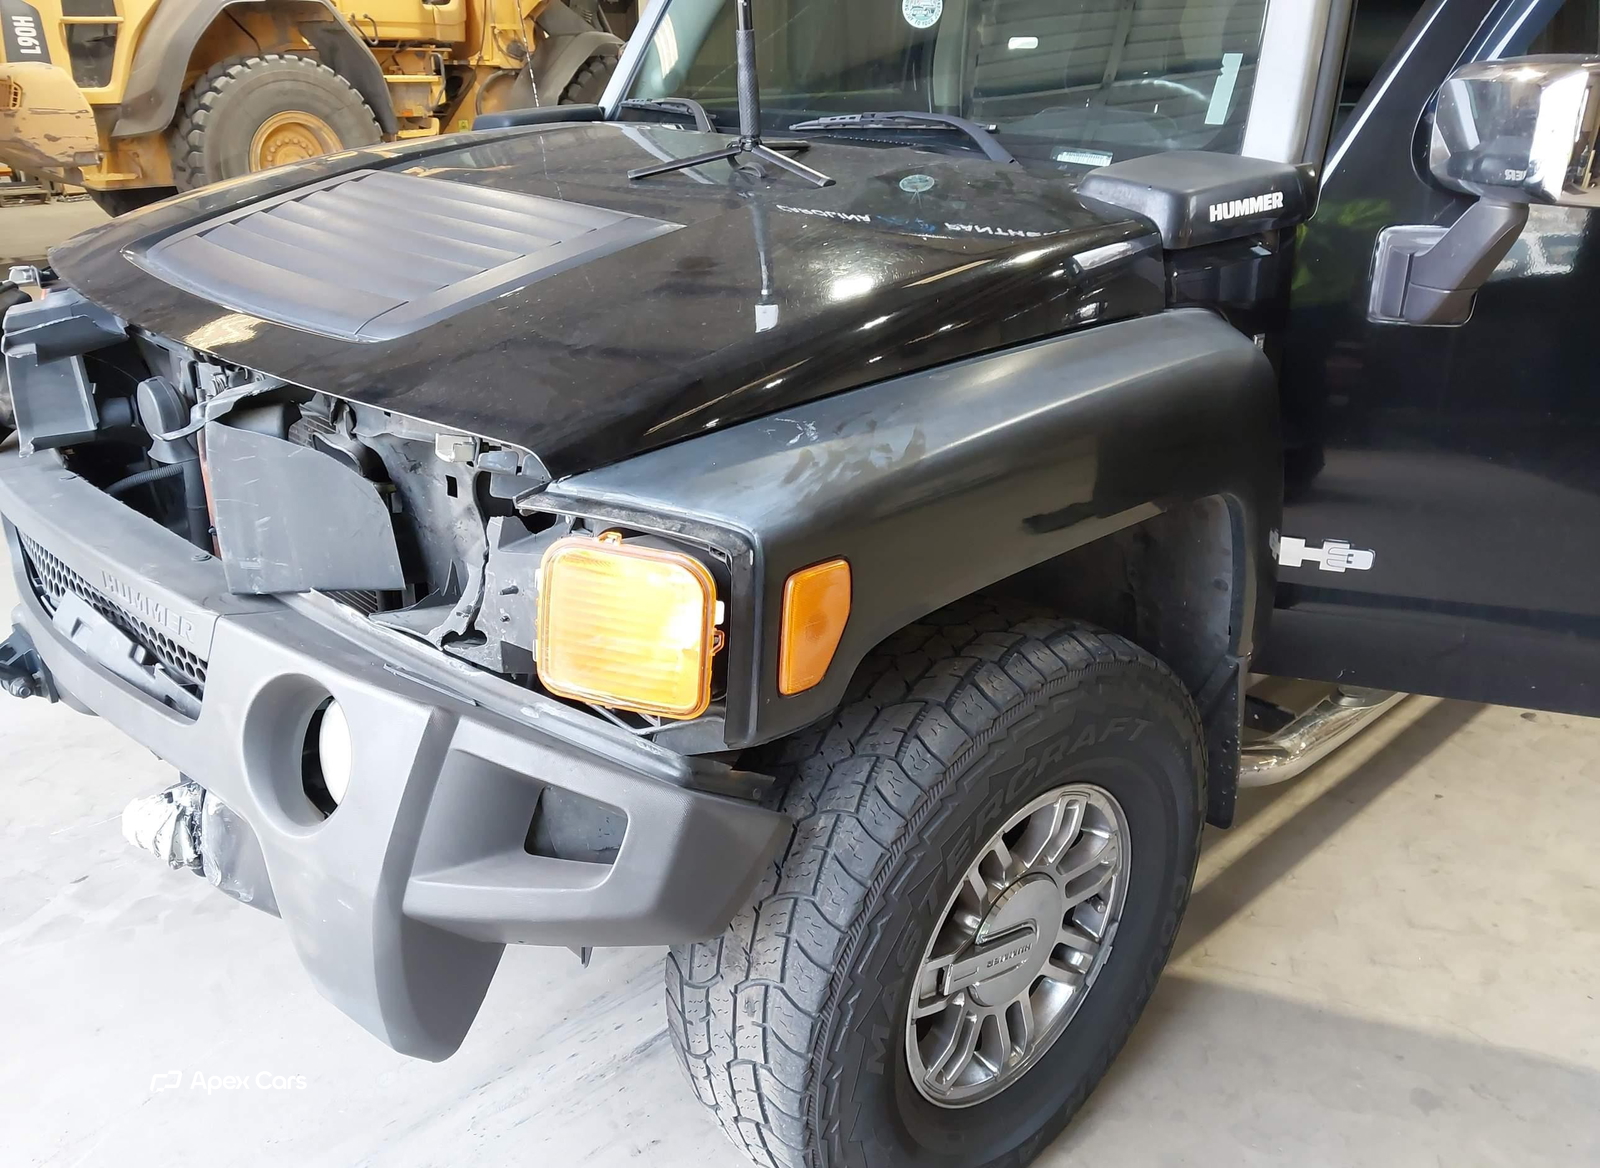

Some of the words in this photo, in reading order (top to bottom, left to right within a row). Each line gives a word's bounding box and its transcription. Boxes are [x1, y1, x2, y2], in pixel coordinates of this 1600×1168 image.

[11, 16, 42, 54] L90H
[1209, 191, 1284, 222] HUMMER
[101, 570, 194, 644] HUMMER
[866, 717, 1153, 1075] MASTERCRAFT
